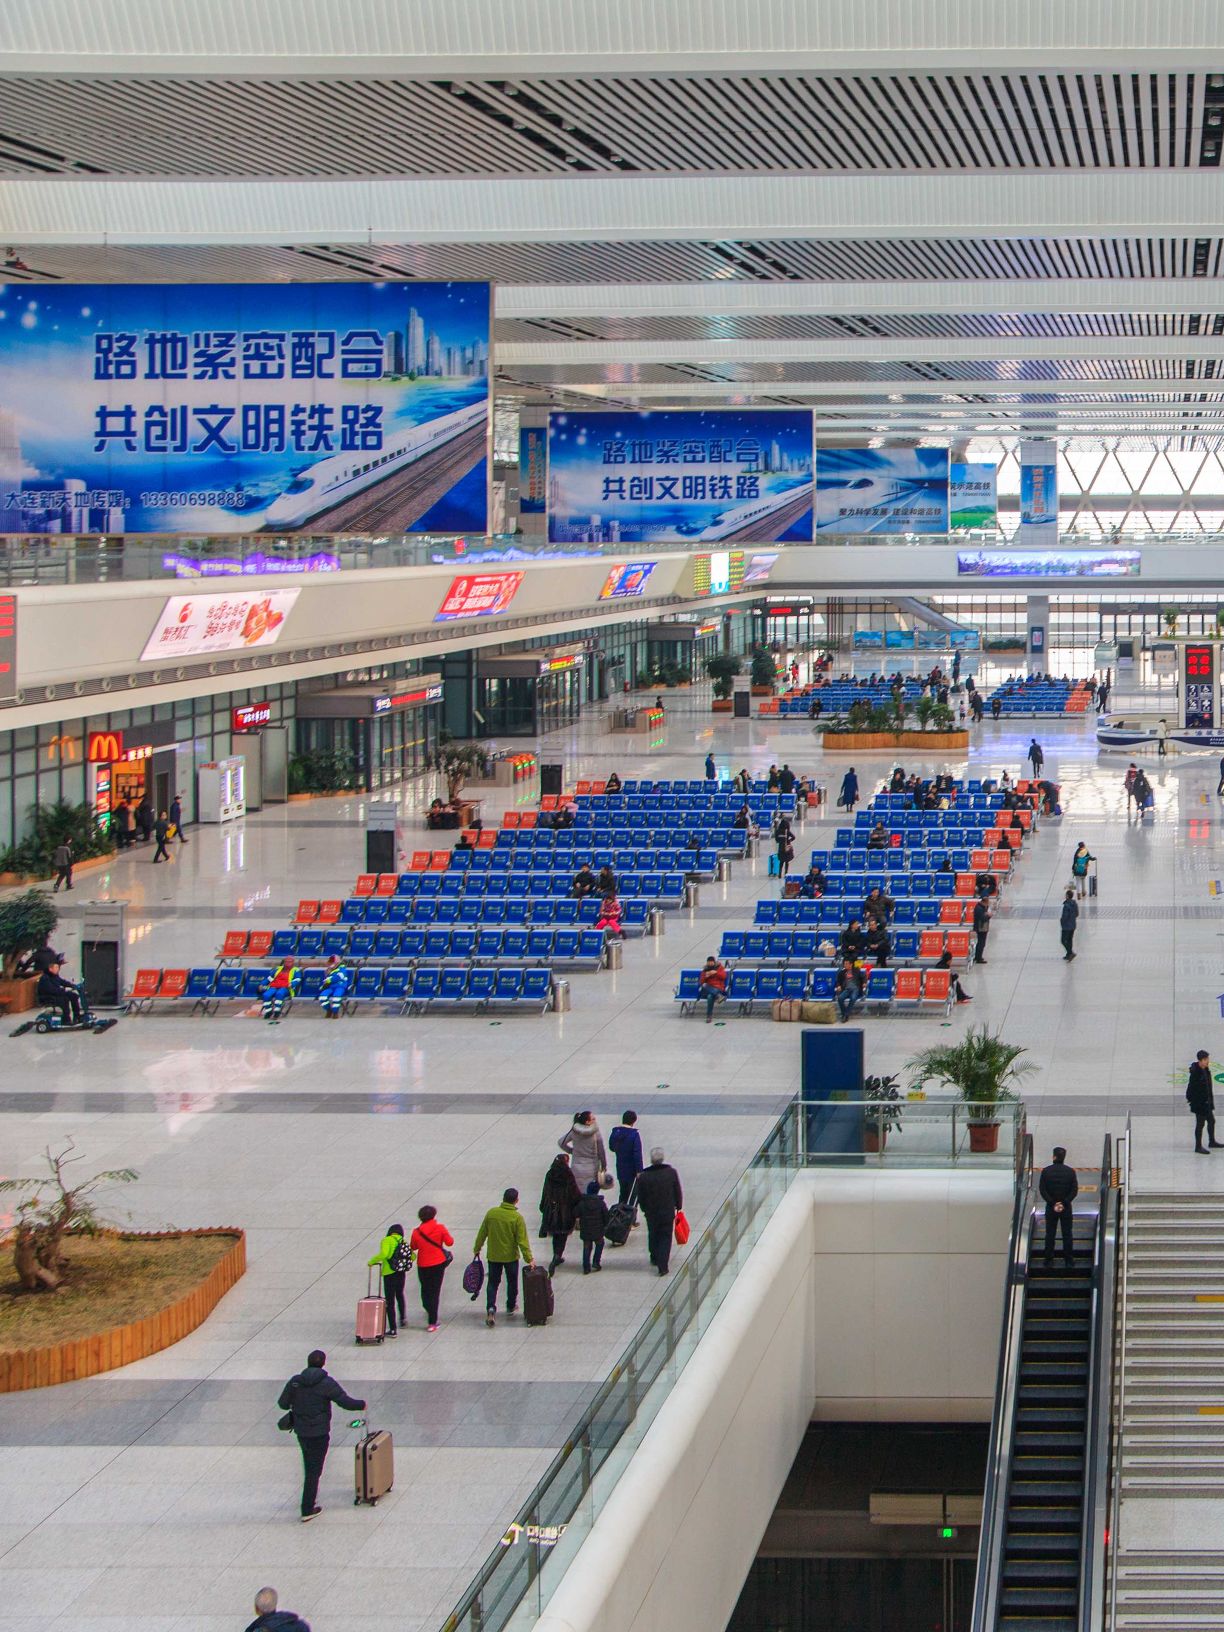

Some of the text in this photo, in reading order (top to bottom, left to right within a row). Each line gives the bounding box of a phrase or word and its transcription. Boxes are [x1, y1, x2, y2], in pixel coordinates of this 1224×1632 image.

[94, 330, 384, 381] 路地紧密配合
[94, 404, 384, 453] 共创文明铁路
[602, 438, 760, 465] 路地紧密配合
[140, 491, 246, 506] 13360698888
[602, 475, 760, 500] 共创文明铁路
